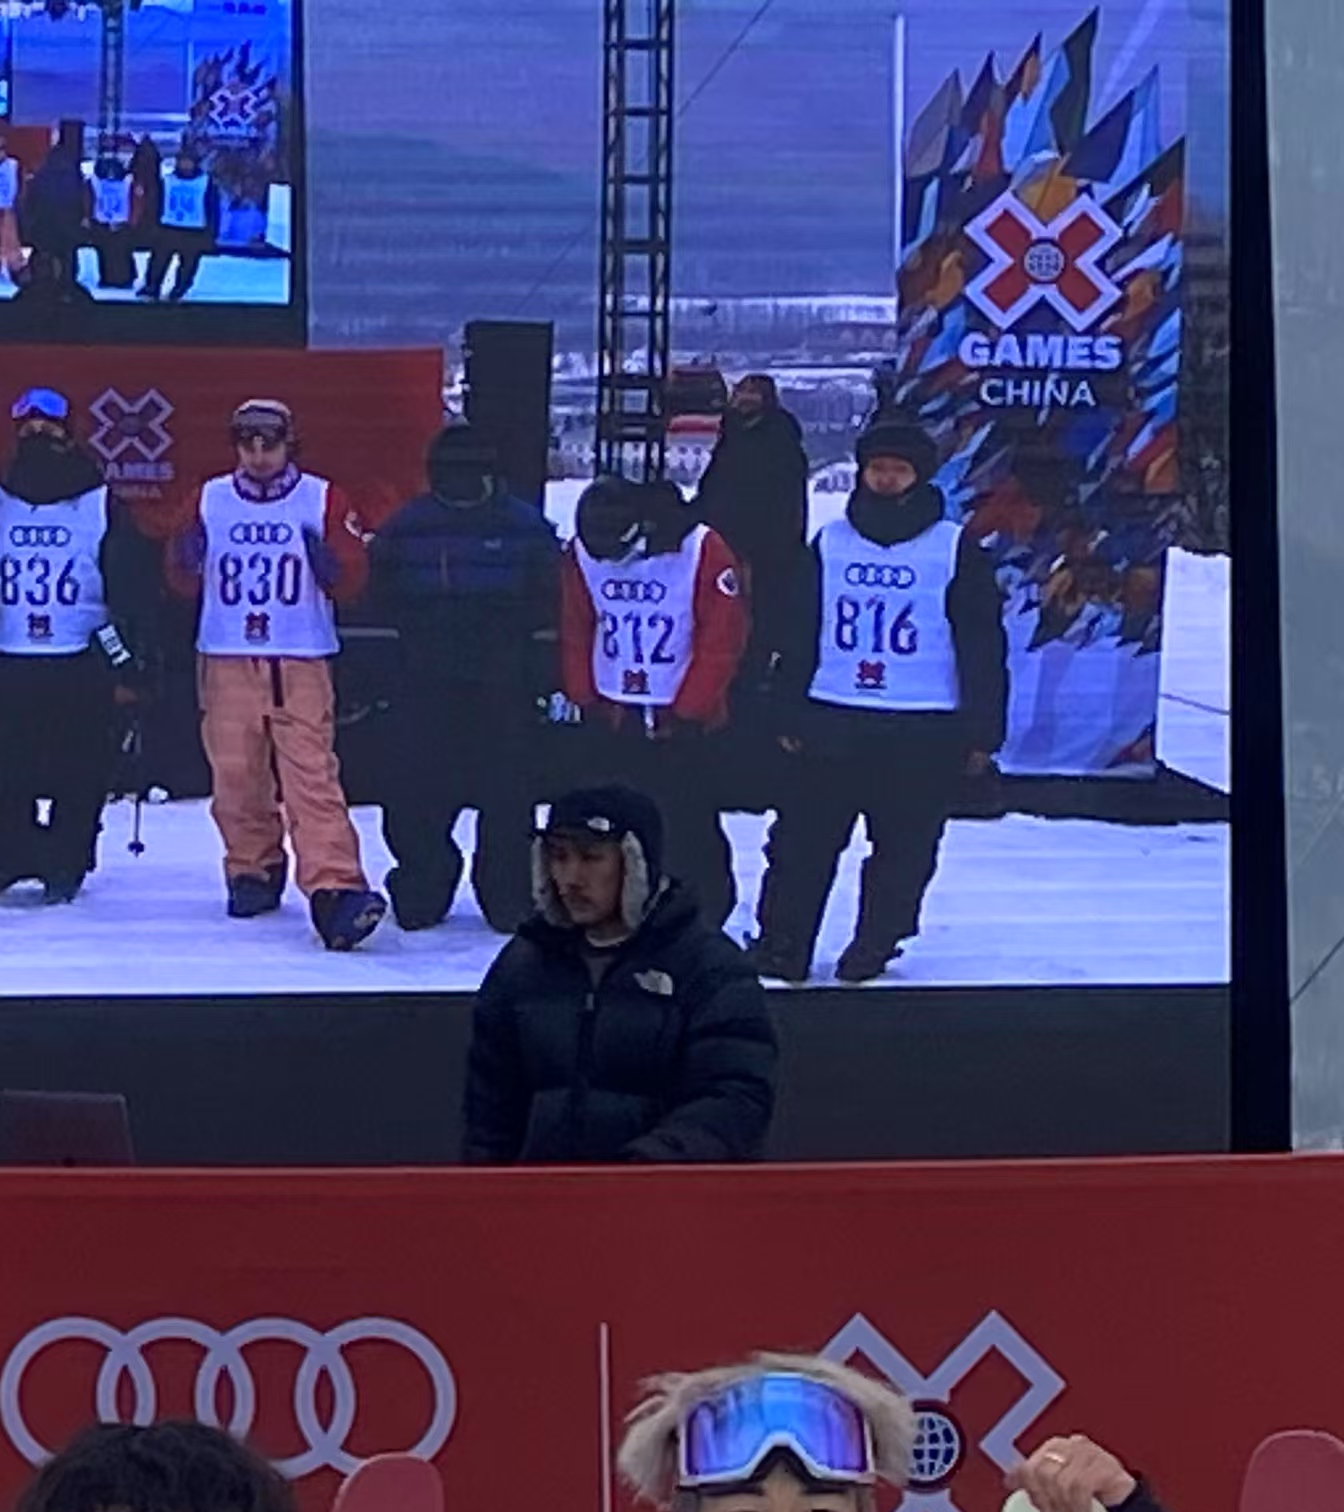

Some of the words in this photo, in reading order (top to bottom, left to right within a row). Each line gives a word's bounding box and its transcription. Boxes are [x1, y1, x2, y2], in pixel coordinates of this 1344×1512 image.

[959, 332, 1123, 369] GAMES
[979, 376, 1096, 407] CHINA
[0, 553, 80, 606] 836
[219, 553, 302, 607] 830
[601, 610, 676, 665] 812
[835, 595, 919, 656] 816
